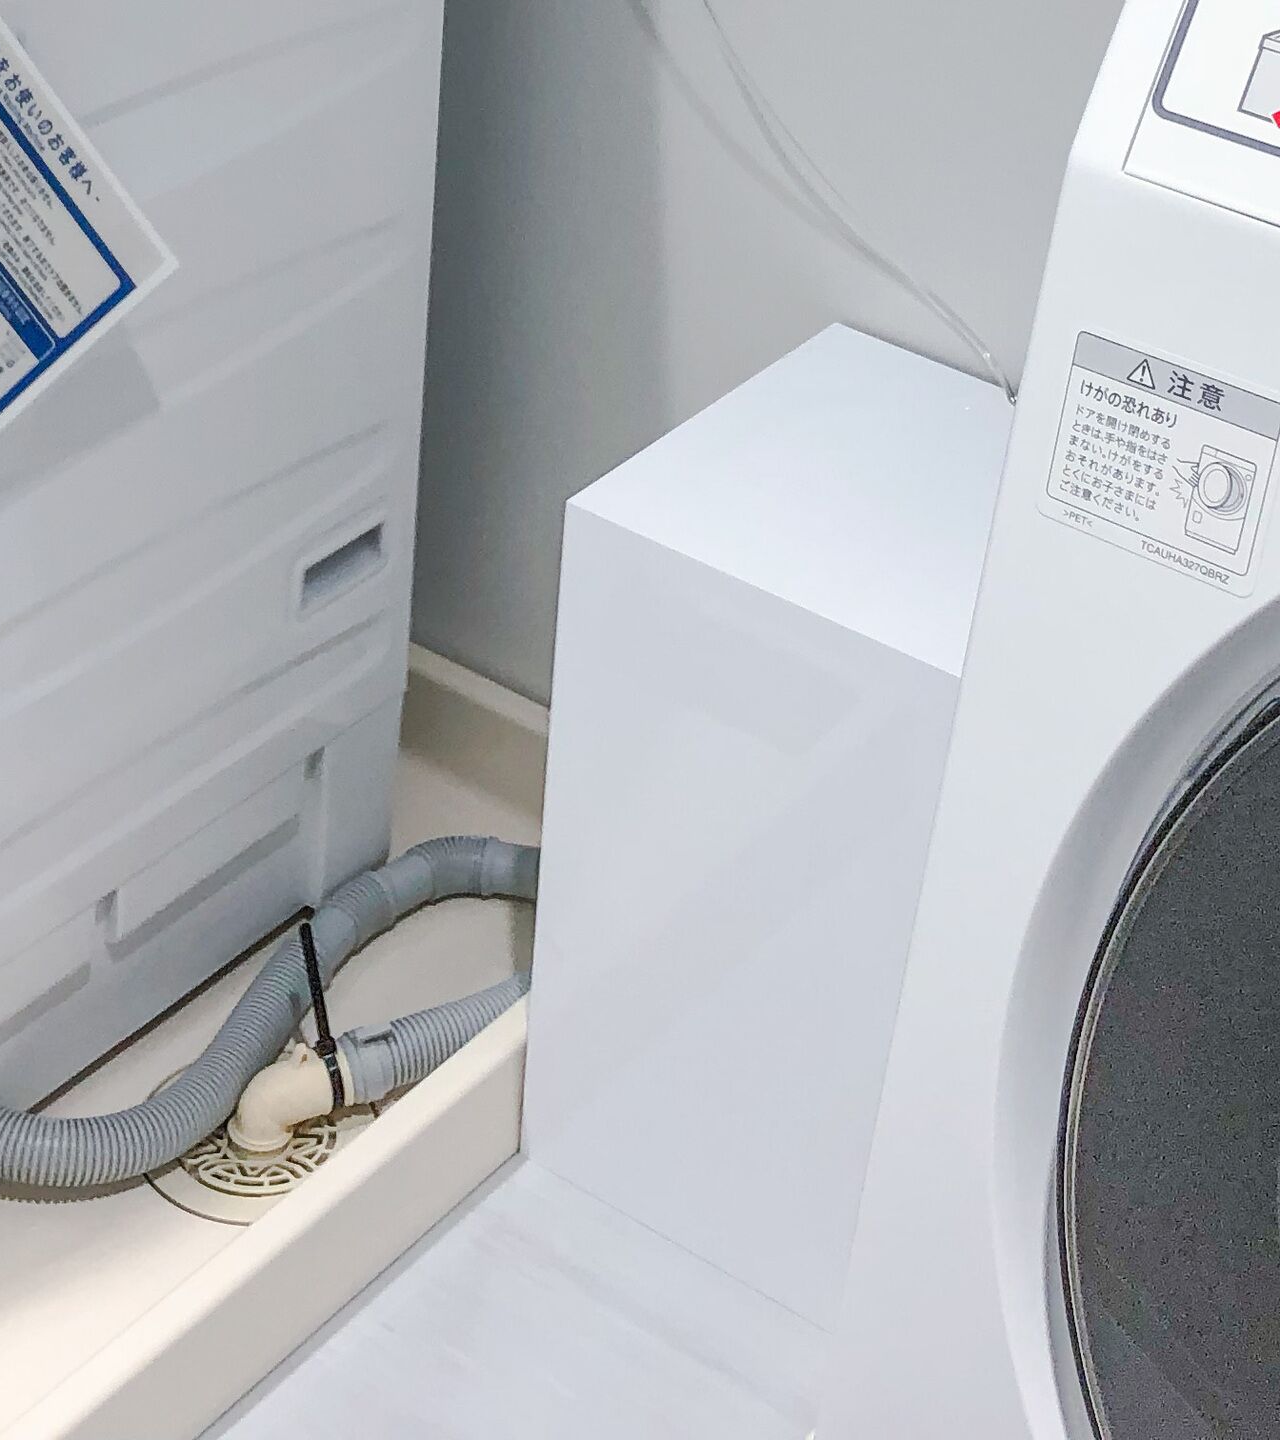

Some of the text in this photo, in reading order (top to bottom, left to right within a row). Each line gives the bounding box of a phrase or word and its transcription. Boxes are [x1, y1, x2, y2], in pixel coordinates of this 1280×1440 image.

[1080, 379, 1177, 428] けがの恐れあり
[1167, 370, 1225, 411] 注意
[1074, 404, 1170, 449] ドアを開け閉めする
[1062, 466, 1156, 510] とくにお子さまには
